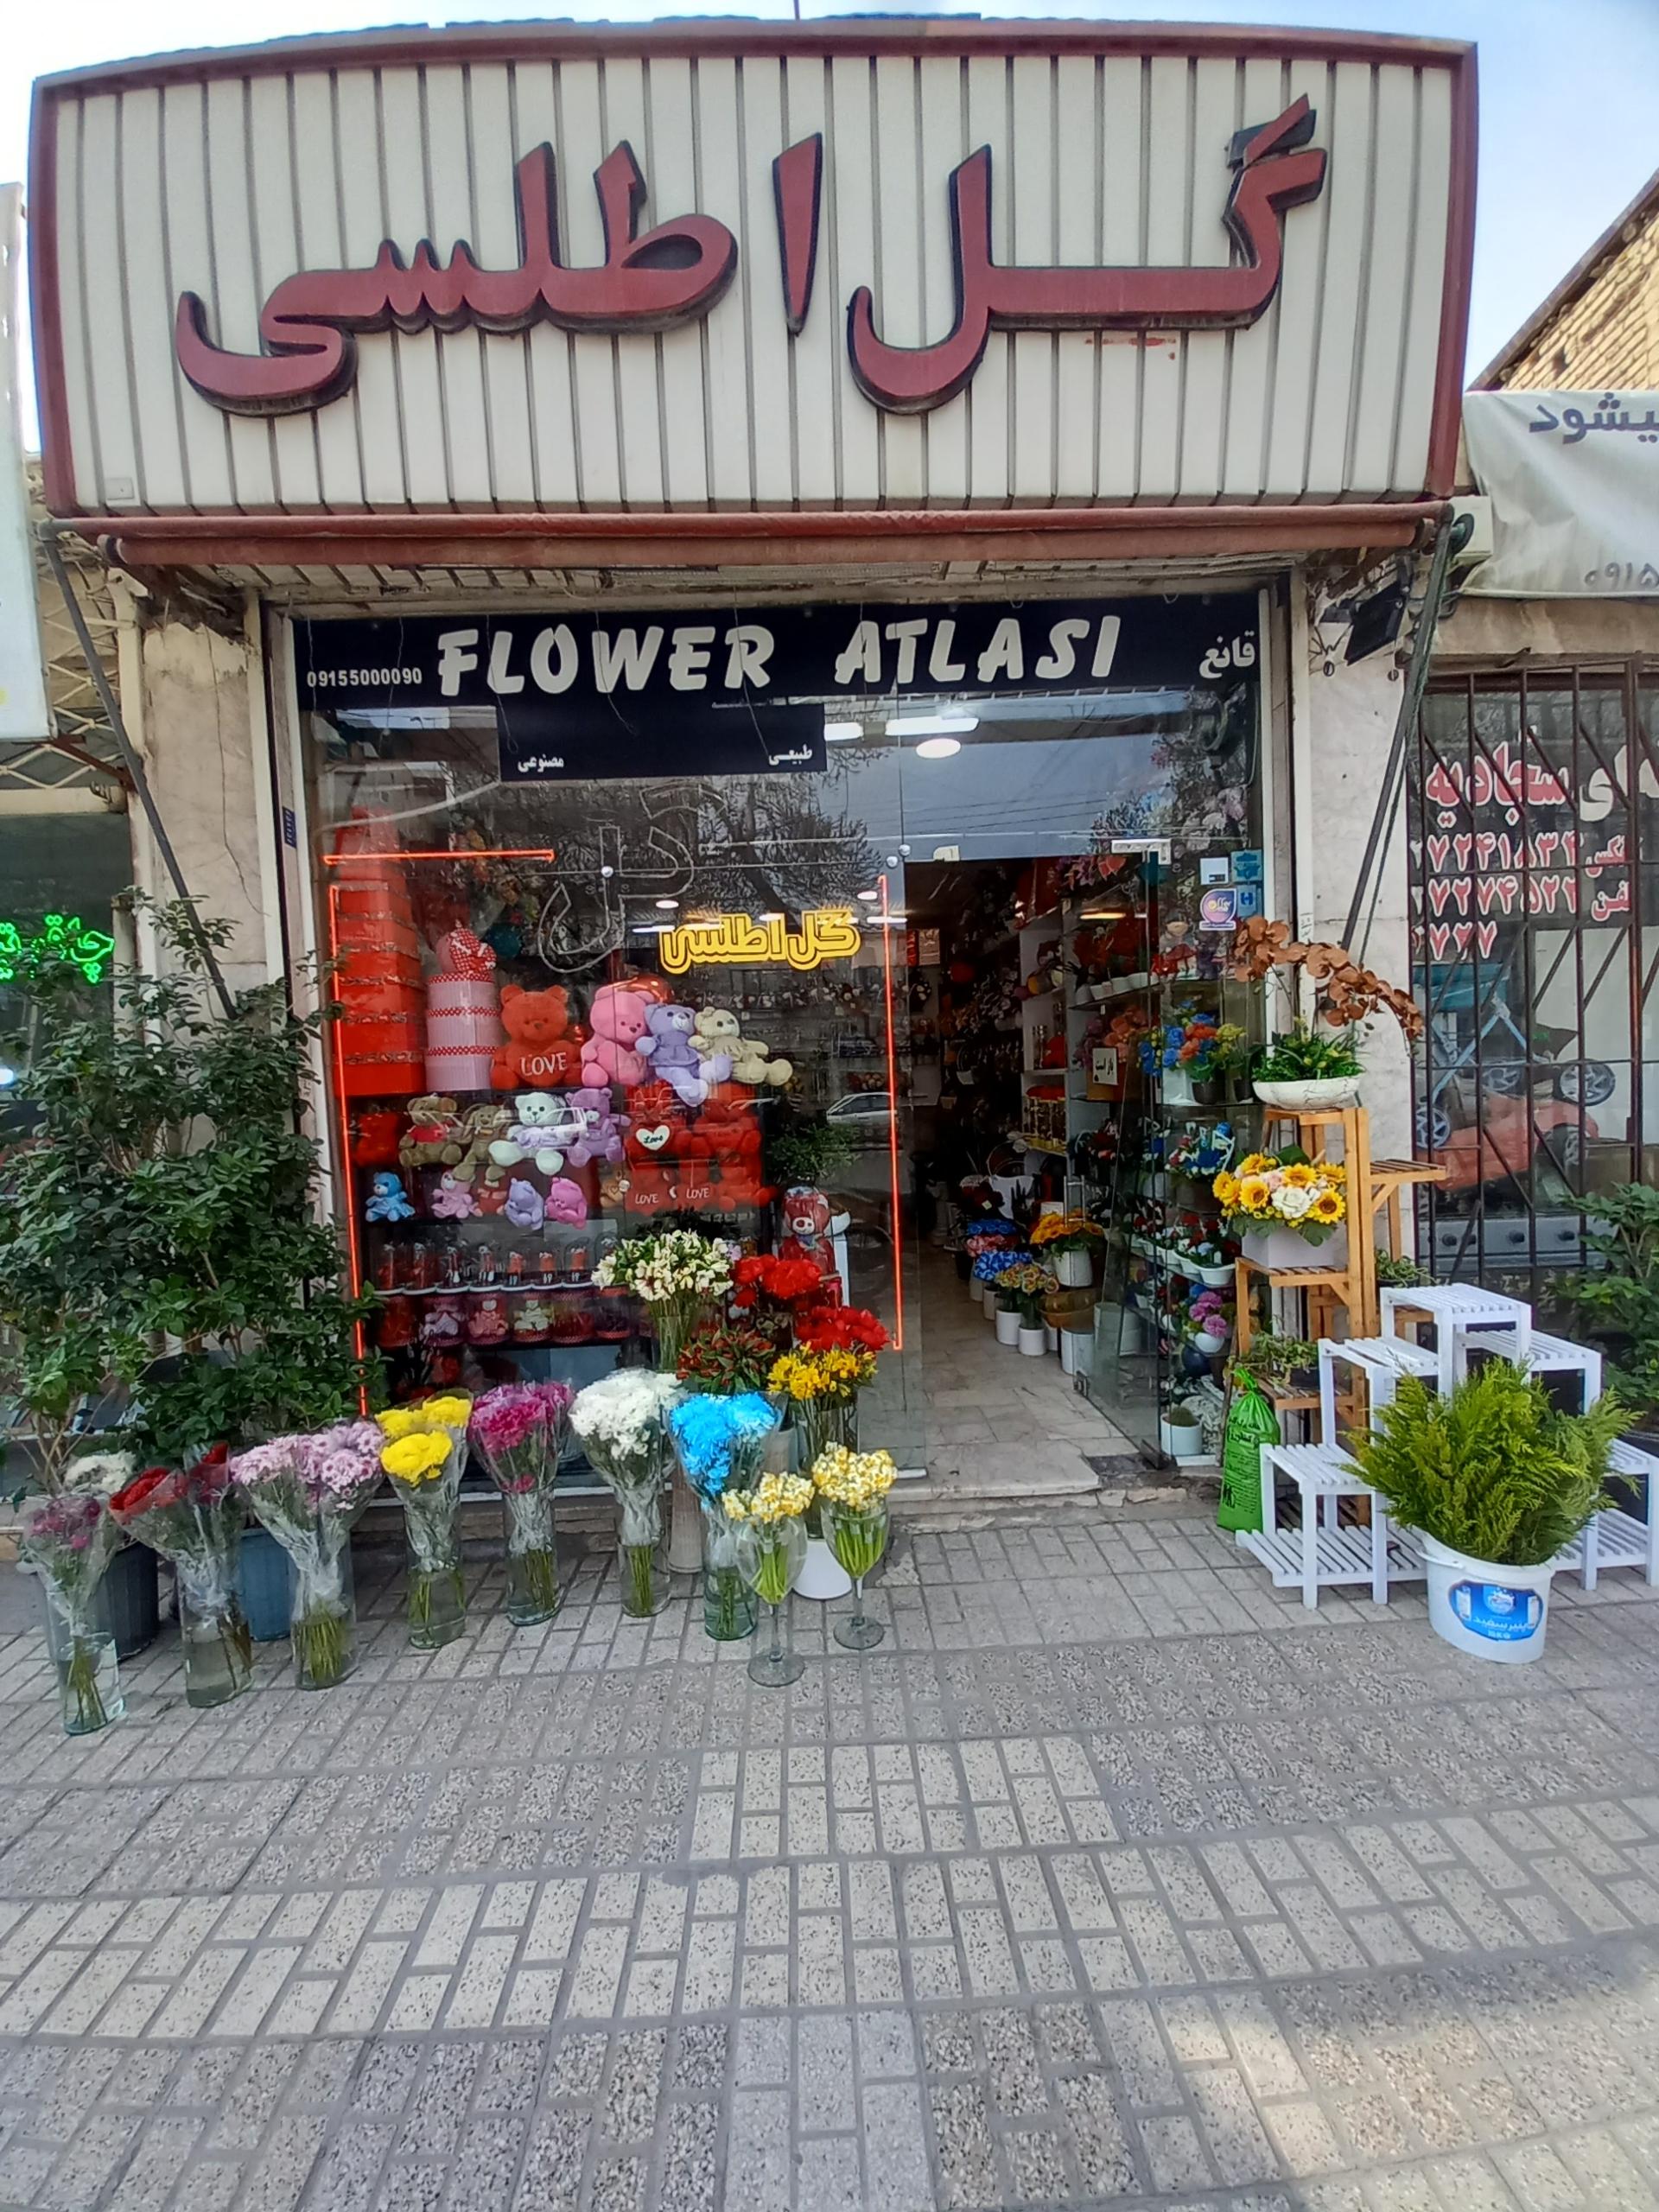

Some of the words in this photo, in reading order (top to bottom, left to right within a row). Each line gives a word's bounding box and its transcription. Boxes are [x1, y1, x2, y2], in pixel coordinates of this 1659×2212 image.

[176, 132, 823, 418] اطلسی
[847, 93, 1327, 416] گل
[1529, 391, 1659, 445] یشود
[306, 667, 423, 688] 09155000090
[438, 623, 775, 696] FLOWER
[835, 615, 1122, 684] ATLASI
[1198, 631, 1255, 679] قانع
[518, 753, 564, 773] مصنوعی
[768, 743, 813, 766] طبیعی
[659, 913, 787, 975] اطلسی
[785, 907, 862, 972] گل
[520, 1052, 568, 1077] LOVE
[635, 1193, 659, 1205] LOVE
[686, 1188, 710, 1200] LOVE
